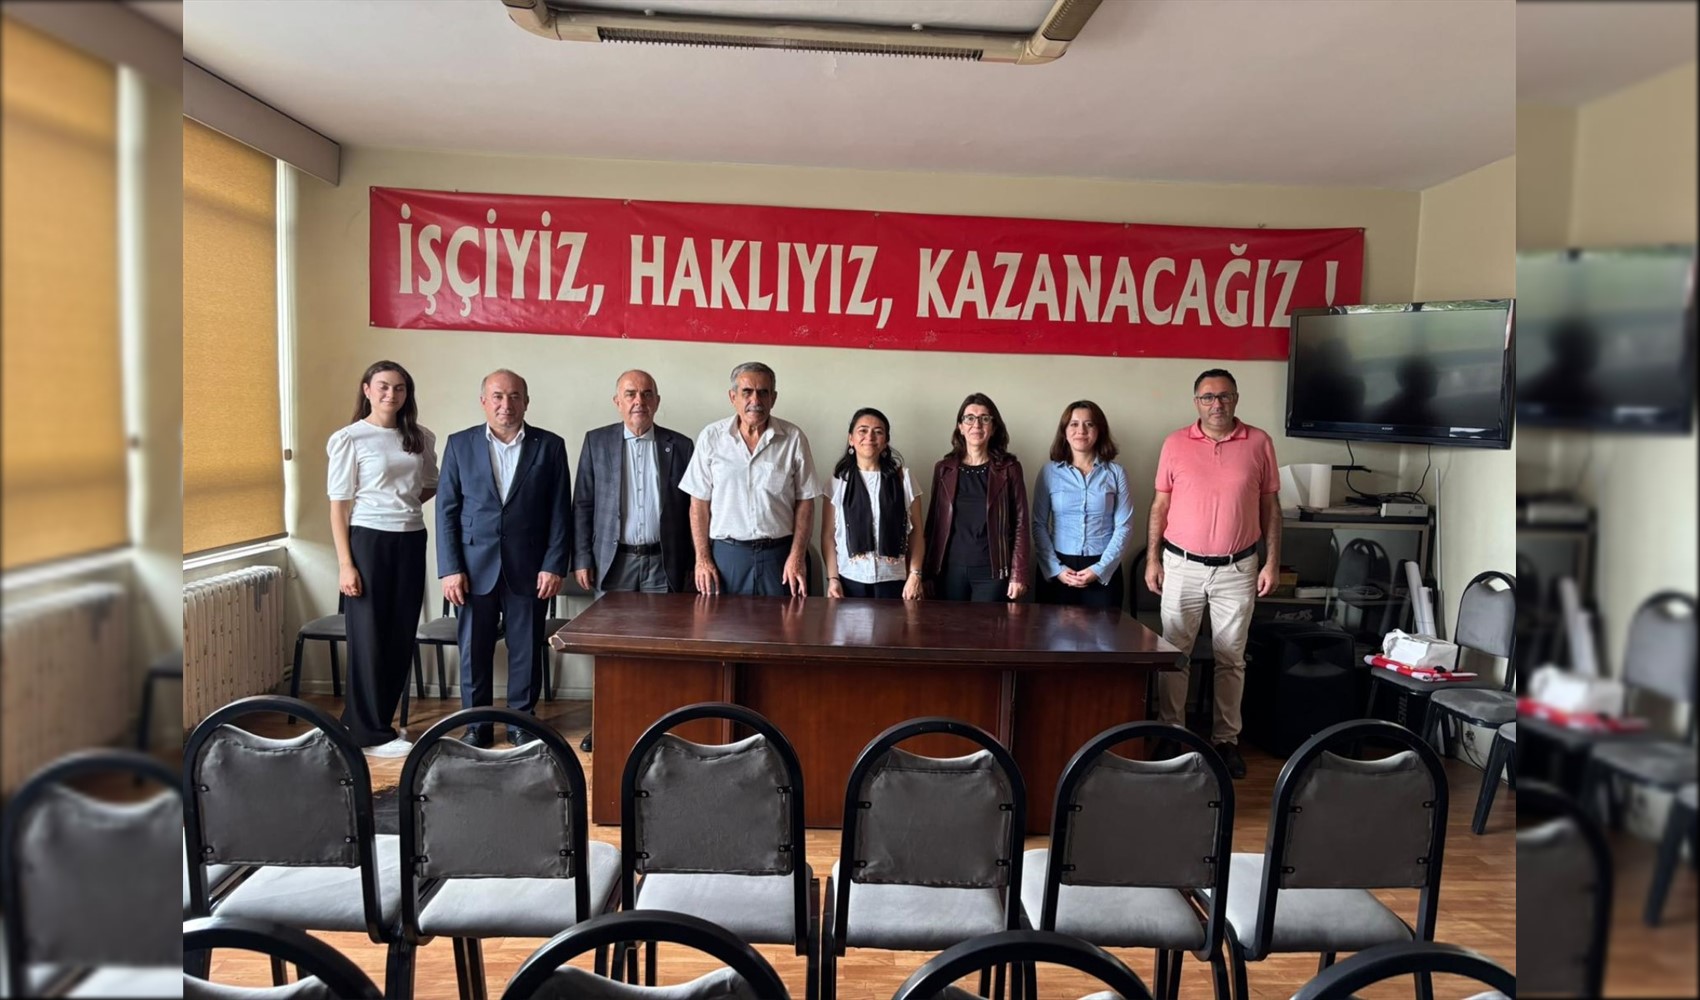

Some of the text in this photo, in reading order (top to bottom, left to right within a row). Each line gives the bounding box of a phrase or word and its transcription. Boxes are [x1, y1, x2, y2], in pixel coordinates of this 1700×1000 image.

[398, 203, 605, 318] İŞÇİYİZ,
[629, 234, 893, 329] HAKLIYIZ,
[916, 243, 1304, 328] KAZANACAĞIZ
